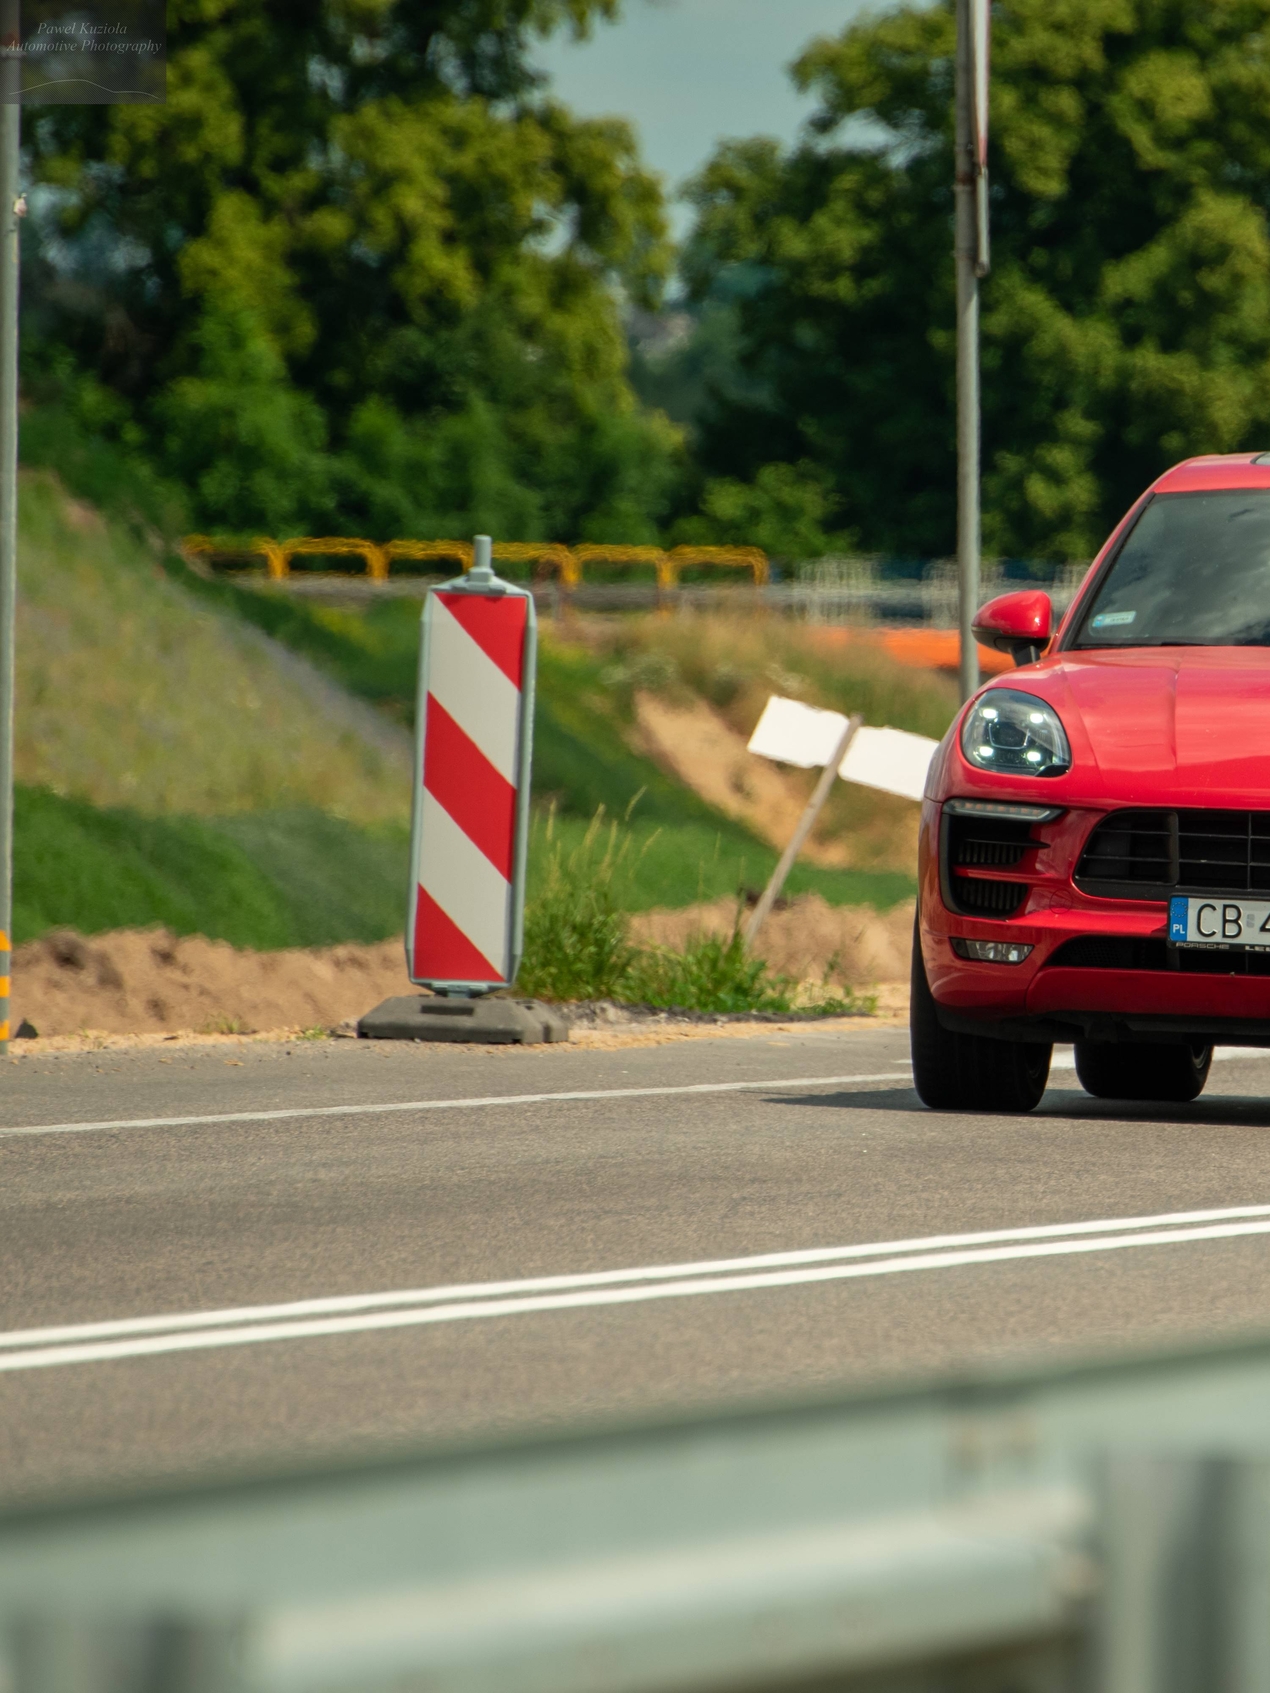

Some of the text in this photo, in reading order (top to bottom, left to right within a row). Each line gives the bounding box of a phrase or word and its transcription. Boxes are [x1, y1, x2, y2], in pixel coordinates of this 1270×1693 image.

[1196, 903, 1243, 939] CB
[1172, 924, 1186, 934] PL
[1176, 942, 1230, 950] PORSCHE
